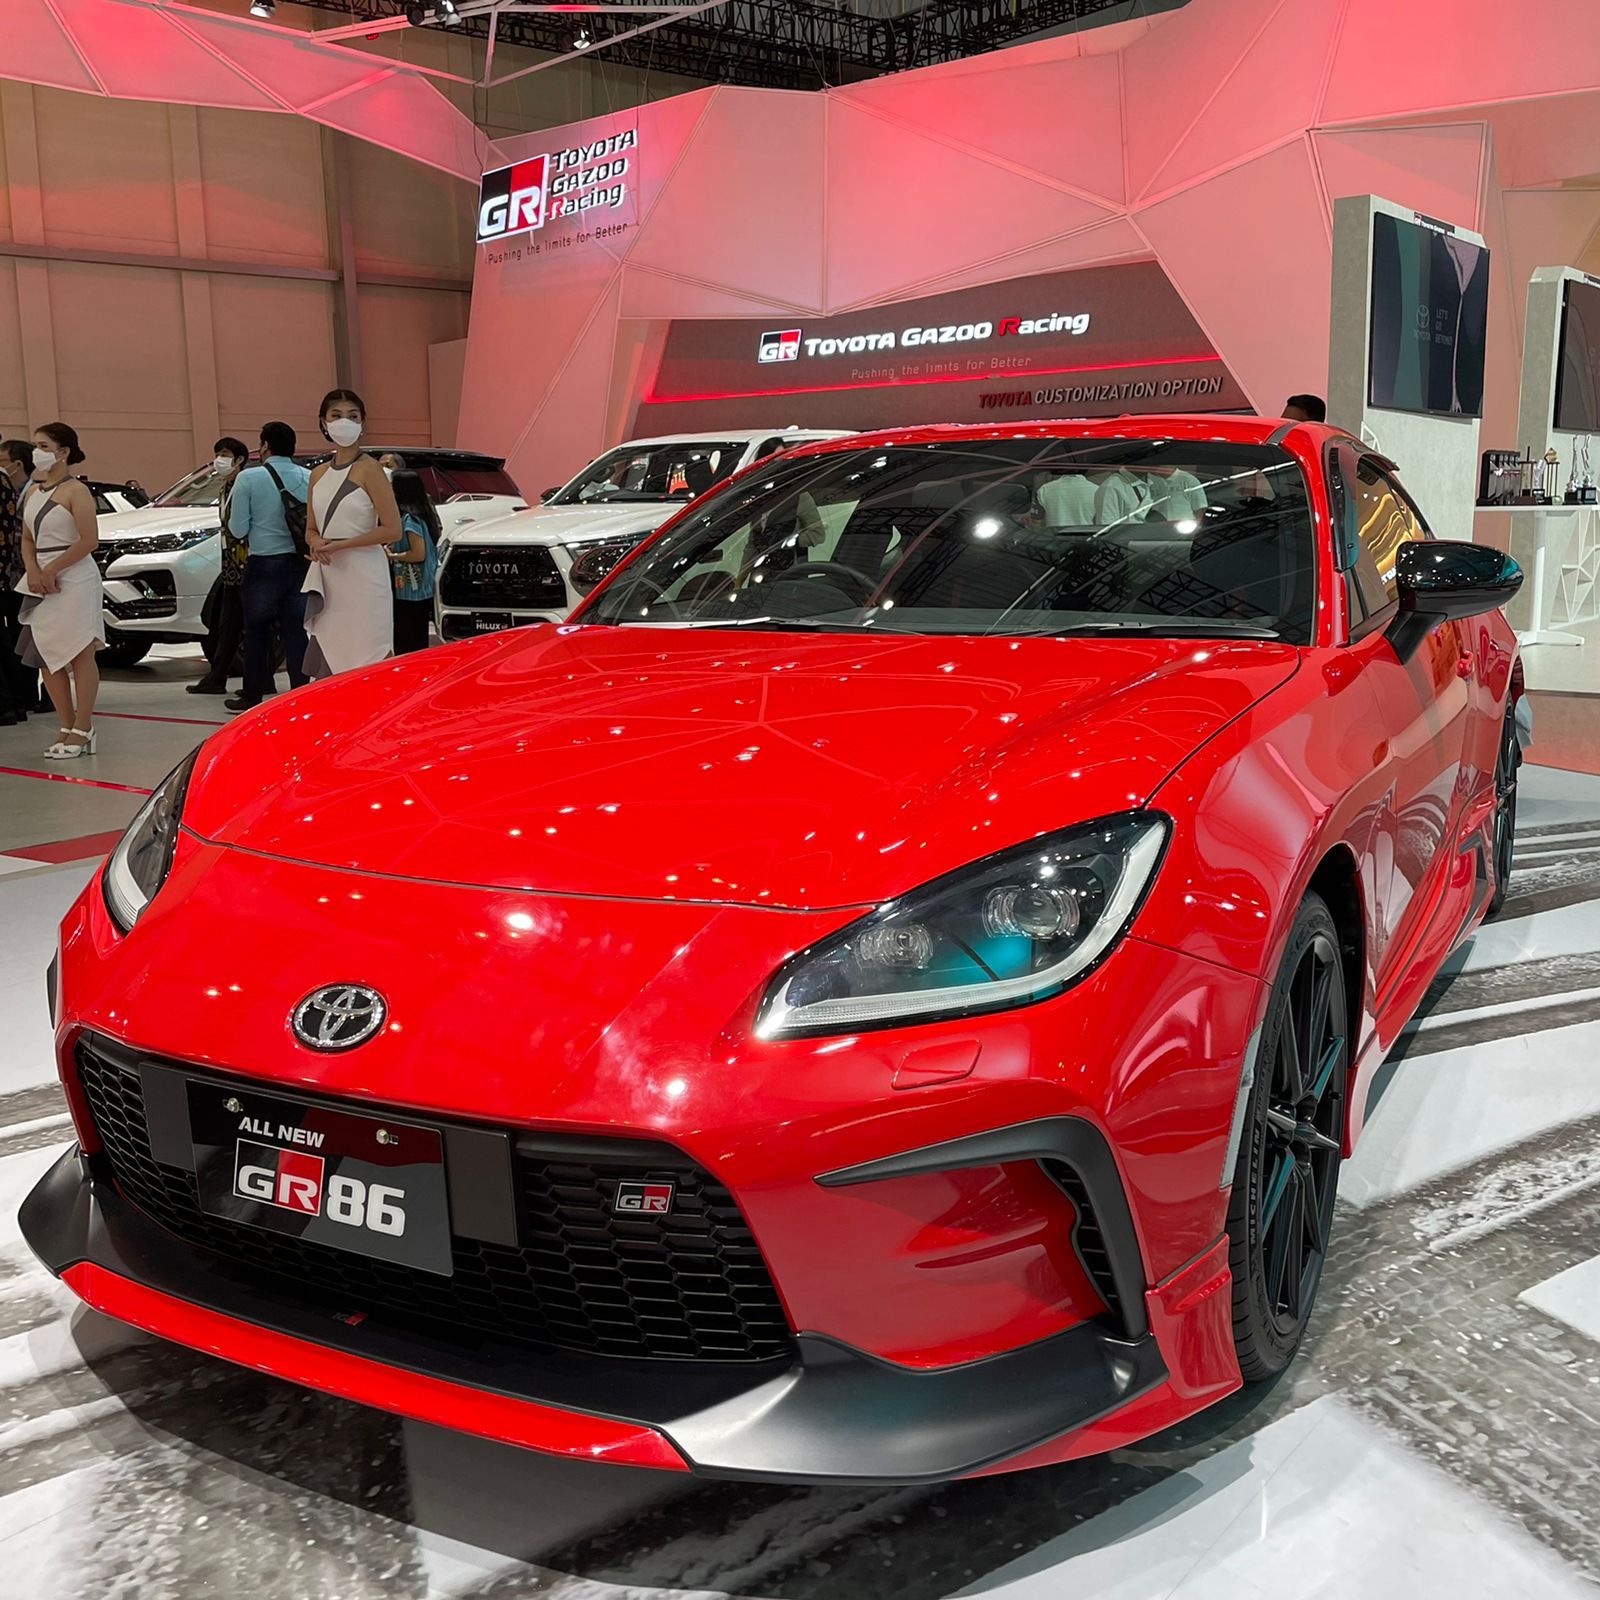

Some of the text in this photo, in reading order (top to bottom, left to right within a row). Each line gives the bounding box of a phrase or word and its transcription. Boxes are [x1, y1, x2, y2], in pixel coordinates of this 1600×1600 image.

[552, 129, 637, 171] TOYOTA
[551, 158, 629, 197] GAZOO
[479, 185, 541, 237] GR
[549, 184, 626, 221] Racing
[488, 223, 628, 264] Pushing the limits for Better
[761, 313, 1090, 361] GR TOYOTA GAZOO Racing
[851, 356, 1031, 381] Pushing the limits for Better
[979, 376, 1222, 409] TOYOTA CUSTOMIZATION OPTION
[468, 561, 519, 575] TOYOTA
[476, 623, 501, 631] HILUX
[238, 1116, 325, 1148] ALL NEW
[237, 1165, 406, 1237] GR 86
[619, 1194, 667, 1210] GR
[1250, 1130, 1260, 1246] MICHELIN
